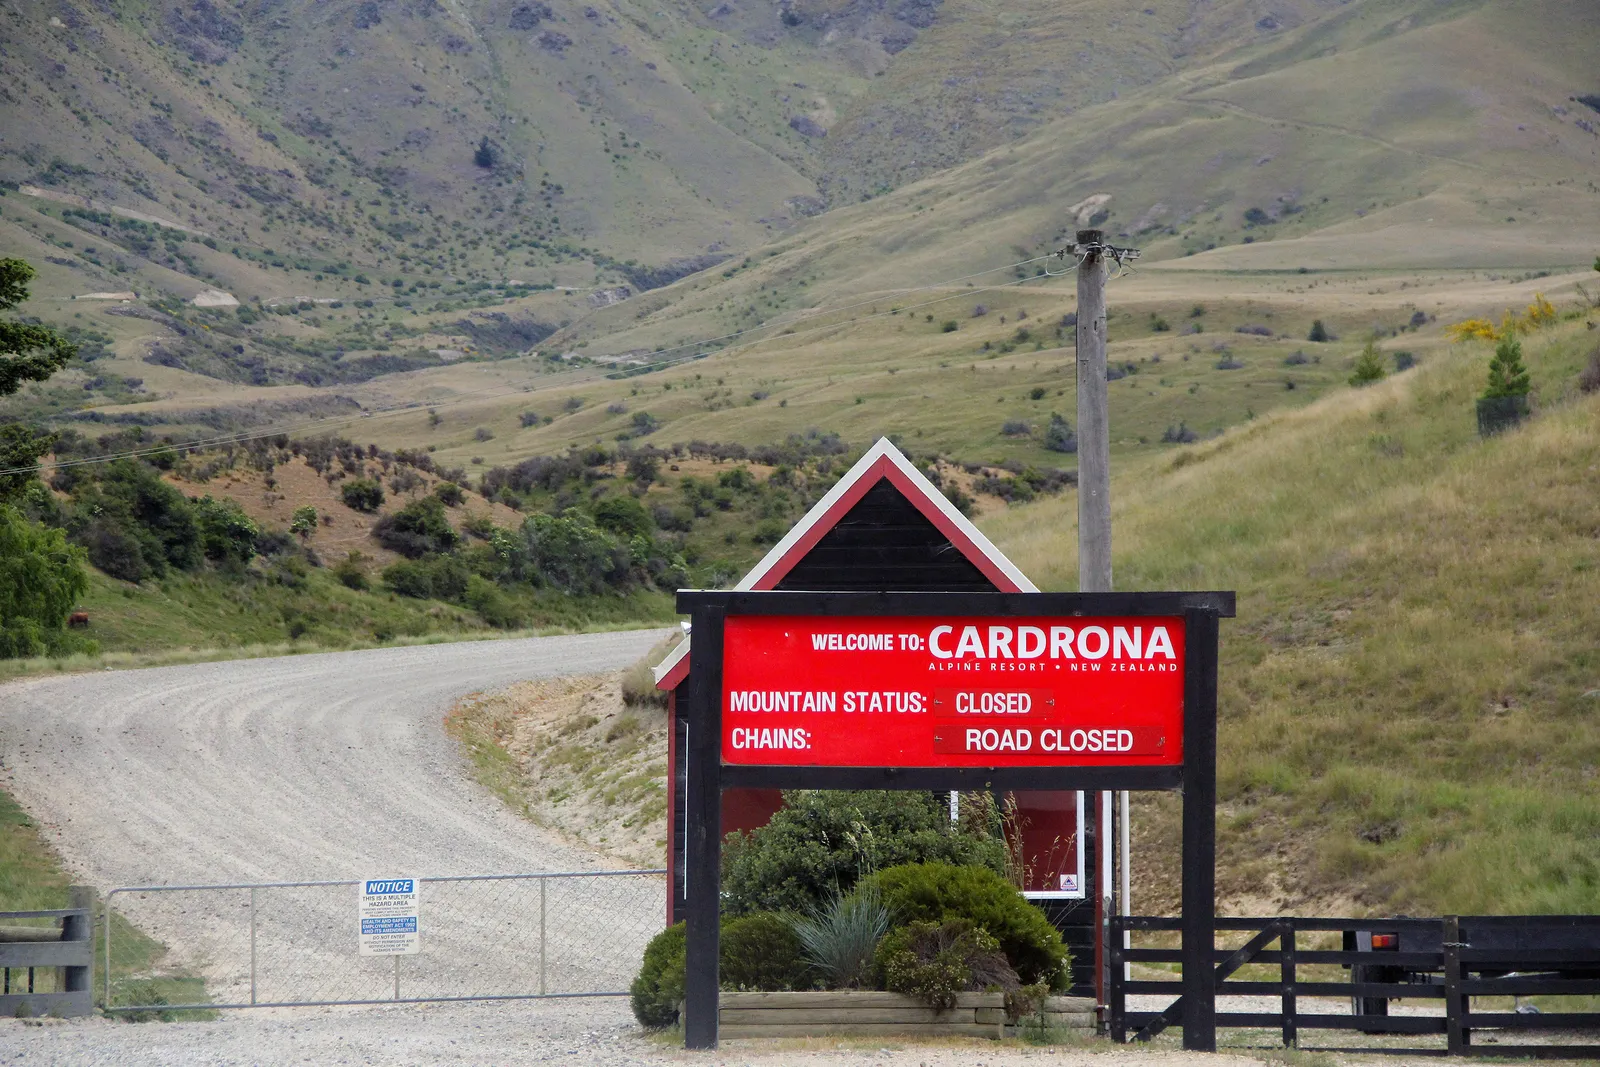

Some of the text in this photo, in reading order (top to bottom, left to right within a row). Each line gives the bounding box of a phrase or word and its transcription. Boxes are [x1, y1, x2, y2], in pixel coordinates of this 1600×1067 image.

[812, 626, 1176, 659] WELCOME TO: CARDRONA
[731, 691, 1031, 713] MOUNTAIN STATUS: CLOSED
[732, 728, 1133, 751] CHAINS: ROAD CLOSED
[369, 881, 411, 893] NOTICE
